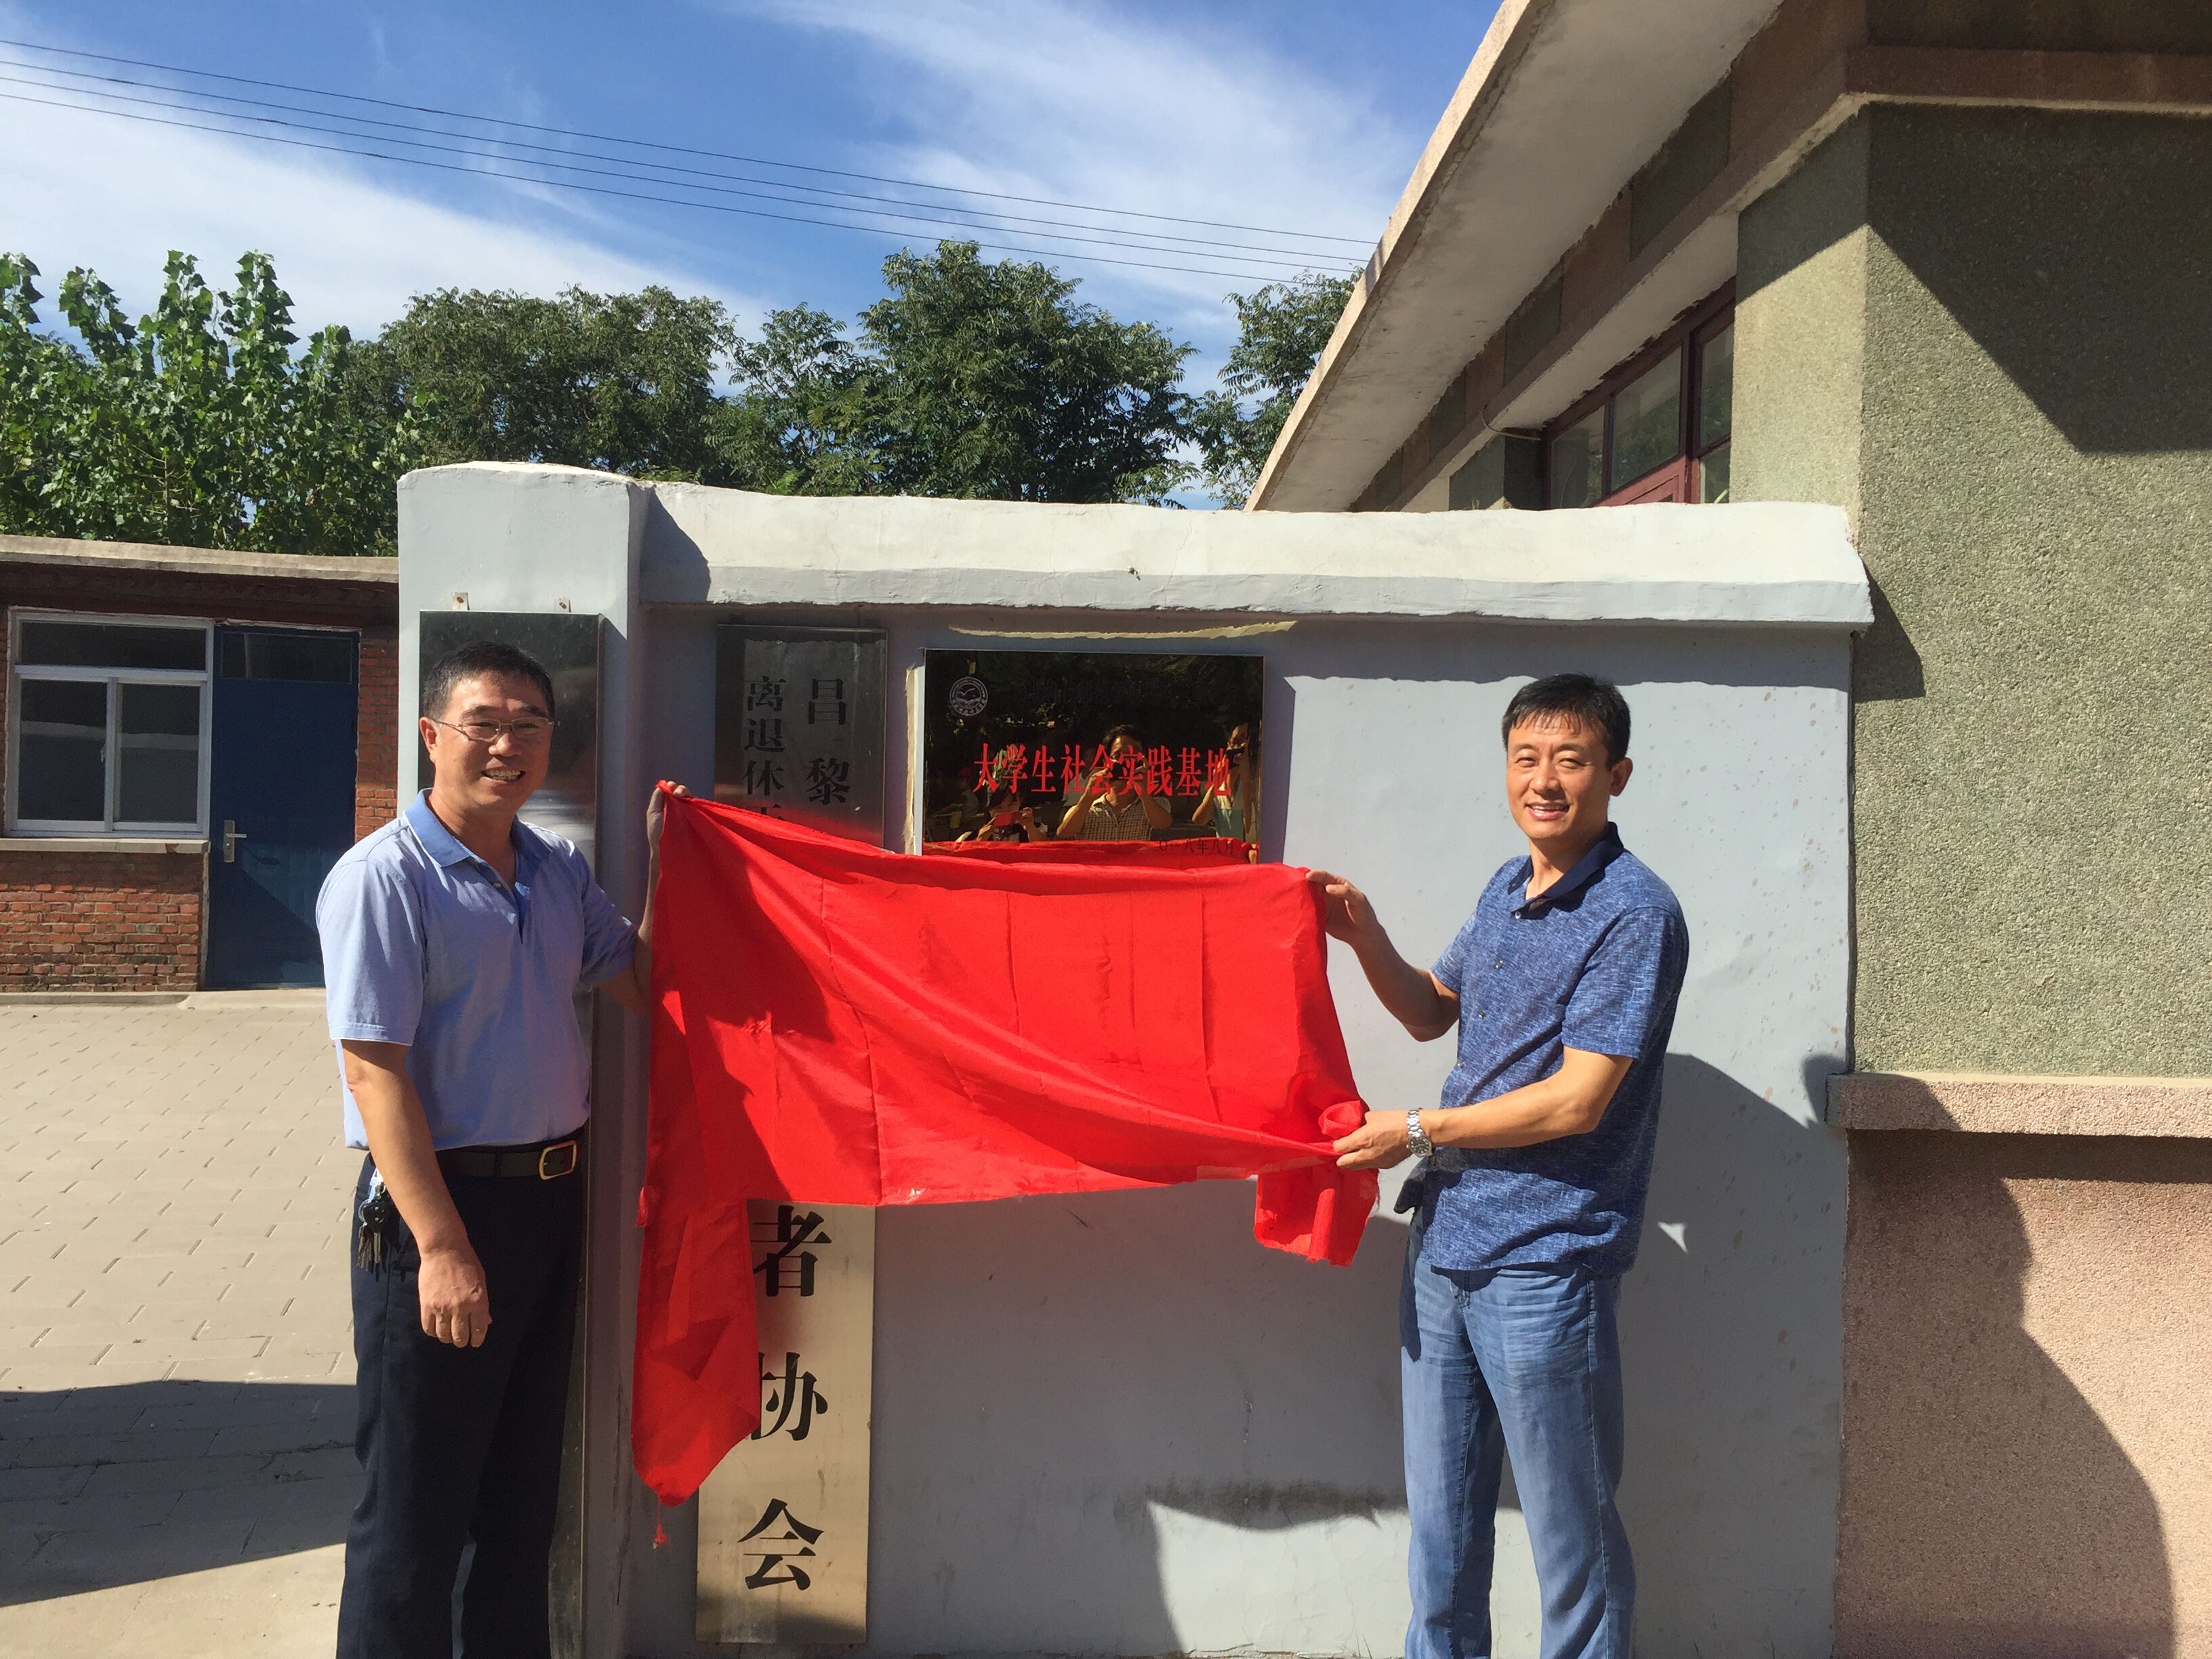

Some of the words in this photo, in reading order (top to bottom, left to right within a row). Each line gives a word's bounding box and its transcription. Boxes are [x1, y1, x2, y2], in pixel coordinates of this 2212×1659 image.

[743, 675, 786, 819] 离退休
[806, 678, 851, 805] 昌黎
[972, 743, 1231, 797] 大学生社会实践基地
[737, 1205, 832, 1591] 者协会
